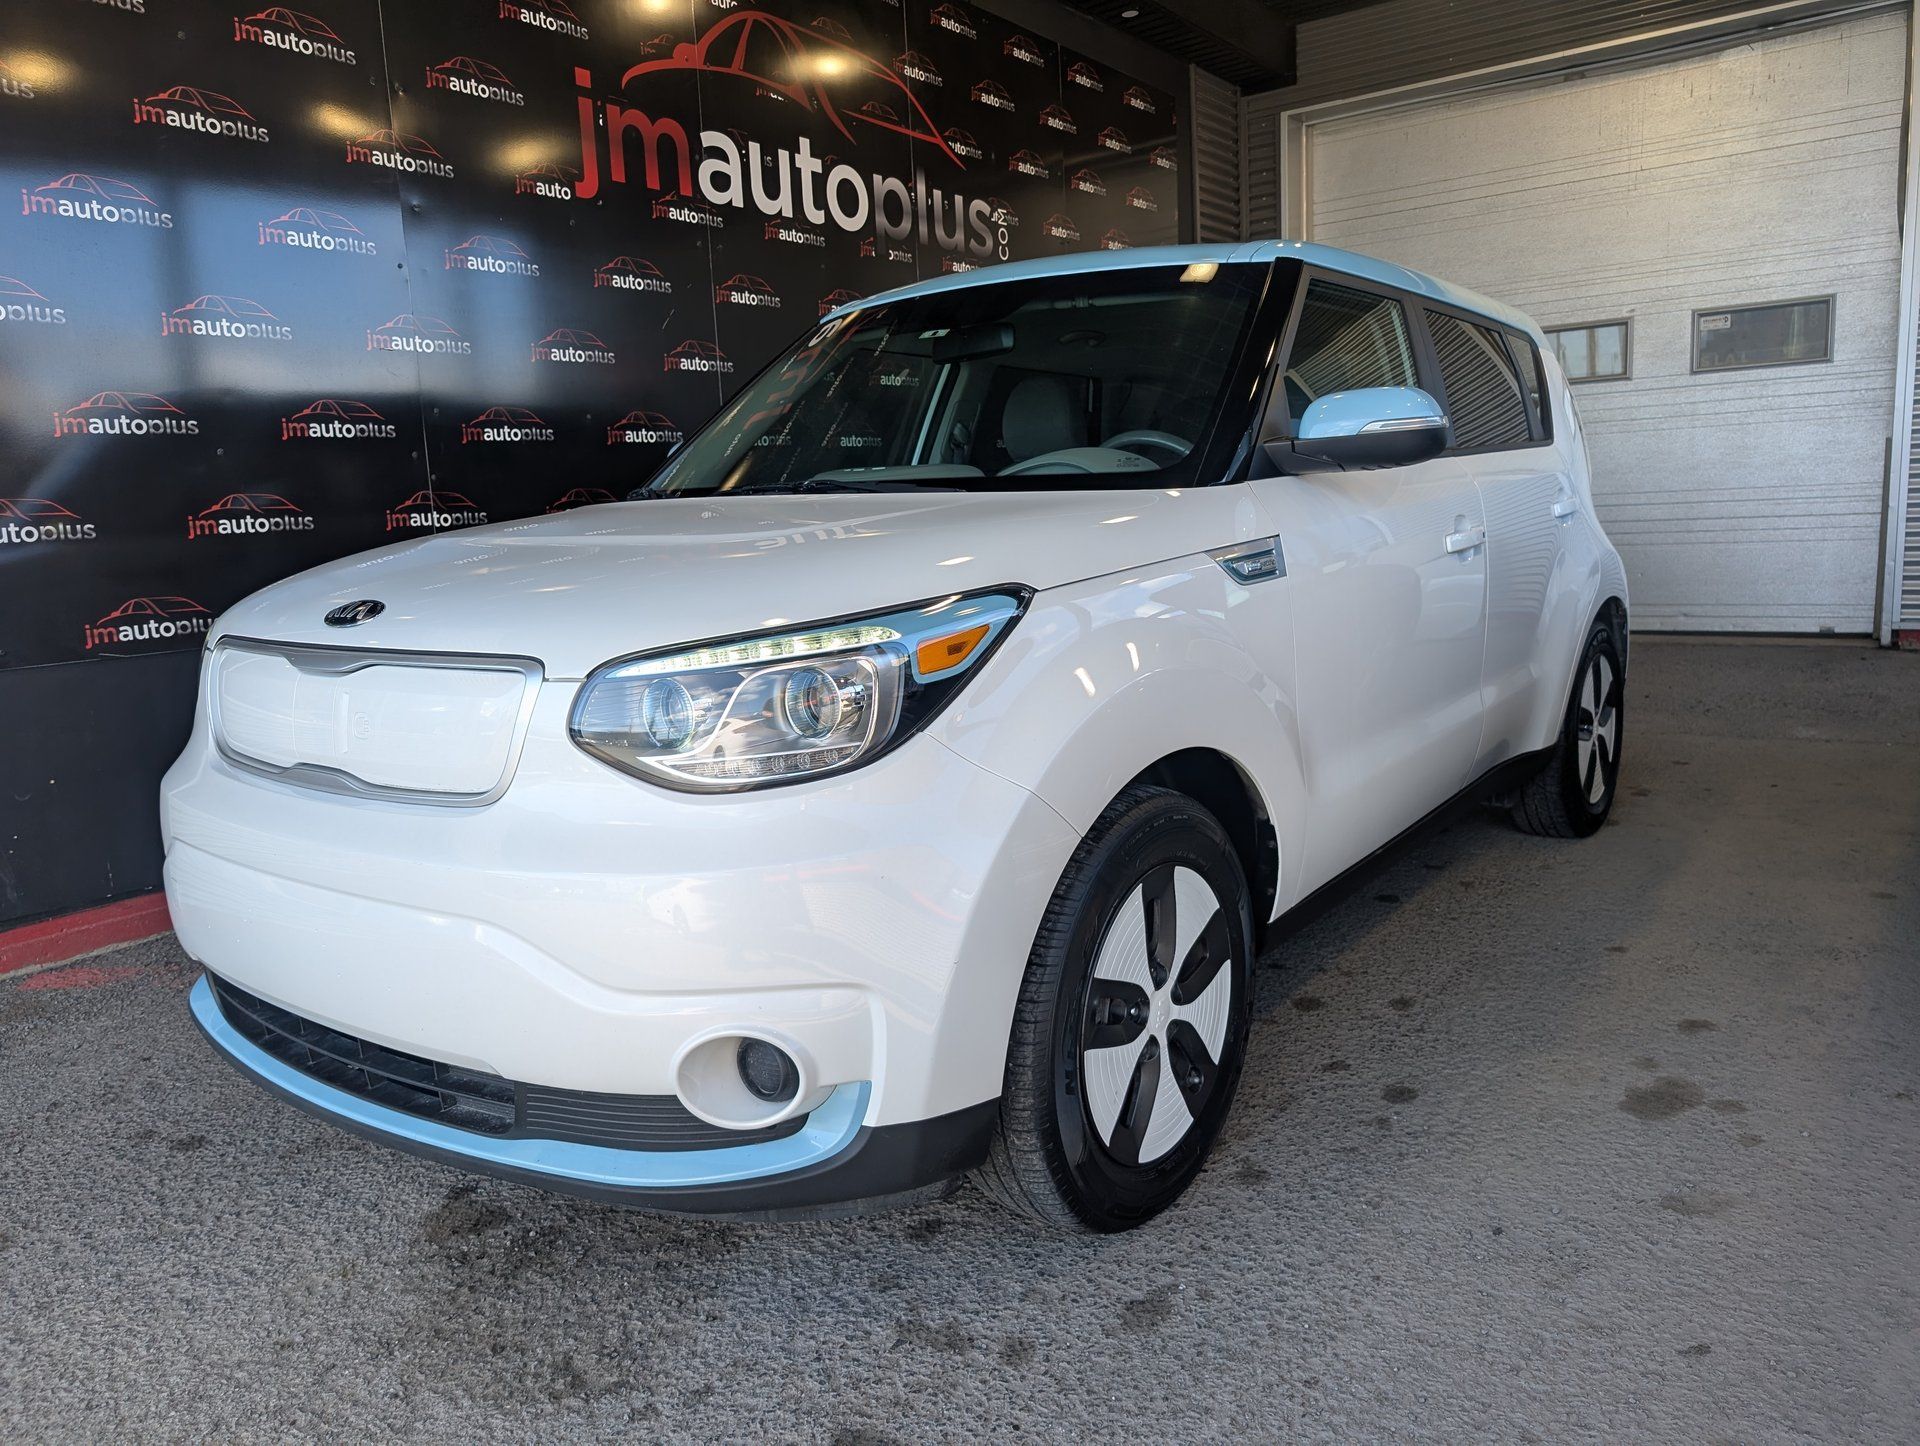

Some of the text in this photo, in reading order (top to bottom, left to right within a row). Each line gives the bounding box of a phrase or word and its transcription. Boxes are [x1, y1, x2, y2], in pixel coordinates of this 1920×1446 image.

[499, 2, 589, 40] jmautoplus
[233, 17, 357, 65] jmautoplus
[425, 66, 525, 106] jmautoplus
[133, 98, 270, 143] jmautoplus
[346, 141, 454, 179] jmautoplus
[574, 66, 993, 257] jmautoplus
[21, 188, 173, 229] jmautoplus
[651, 200, 724, 229] jmautoplus
[258, 221, 377, 256] jmautoplus
[763, 222, 826, 248] jmautoplus
[444, 249, 540, 277] jmautoplus
[593, 268, 673, 294] jmautoplus
[715, 286, 781, 308] jmautoplus
[161, 312, 293, 341] jmautoplus
[366, 329, 472, 355] jmautoplus
[530, 343, 616, 365] jmautoplus
[663, 354, 735, 373] jmautoplus
[53, 412, 200, 438] jmautoplus
[281, 417, 397, 441] jmautoplus
[461, 423, 554, 445] jmautoplus
[607, 426, 684, 446] jmautoplus
[187, 513, 315, 540] jmautoplus
[385, 508, 489, 531] jmautoplus
[85, 615, 213, 650] jmautoplu
